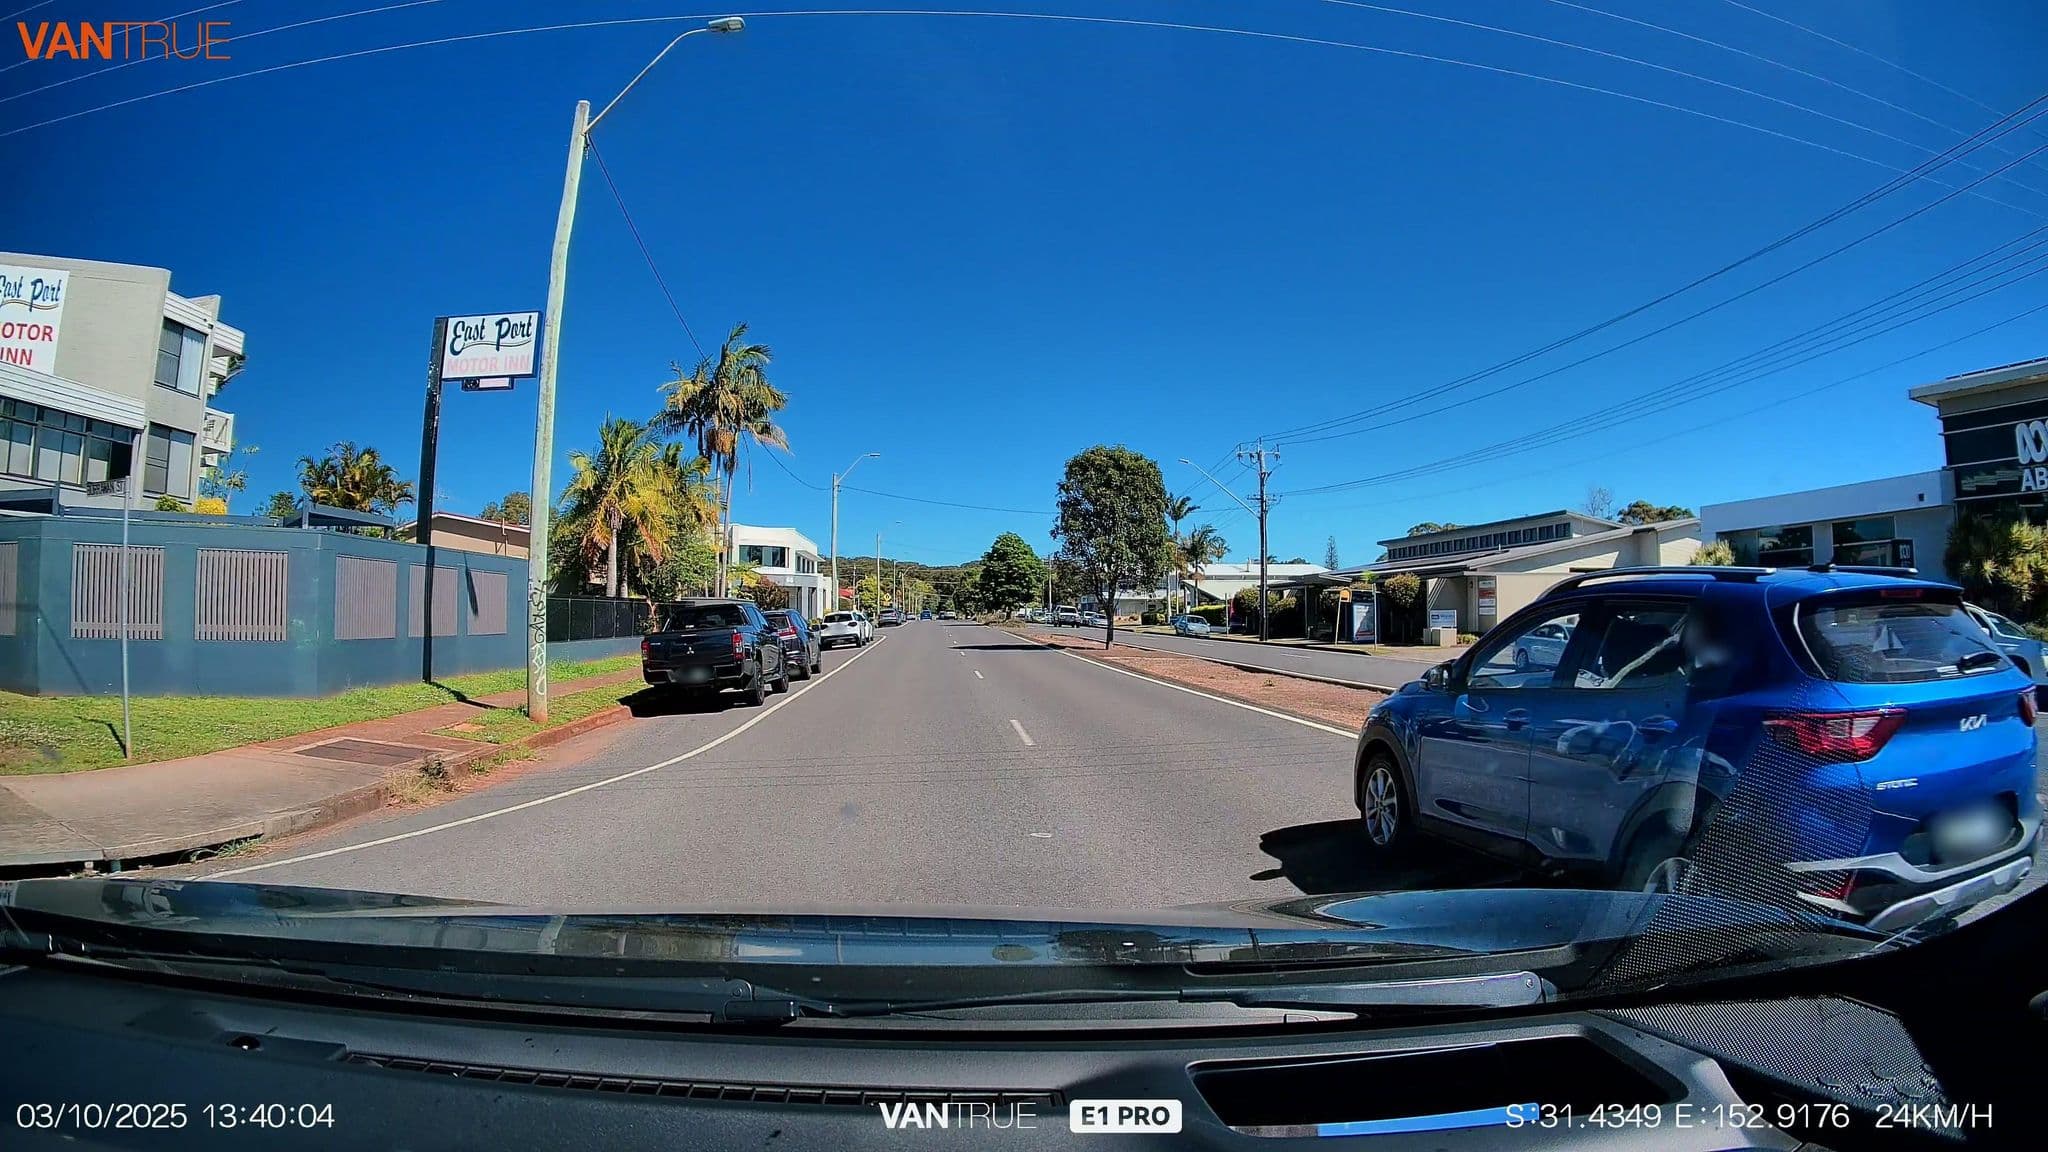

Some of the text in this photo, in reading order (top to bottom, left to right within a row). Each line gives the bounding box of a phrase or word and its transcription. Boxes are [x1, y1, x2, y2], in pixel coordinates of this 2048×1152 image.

[29, 278, 62, 312] Port
[1, 322, 54, 342] OTOR
[450, 315, 532, 356] East Port
[0, 347, 33, 366] INN
[447, 354, 530, 374] MOTOR INN
[2021, 467, 2048, 492] AB
[1960, 714, 1987, 732] KIA
